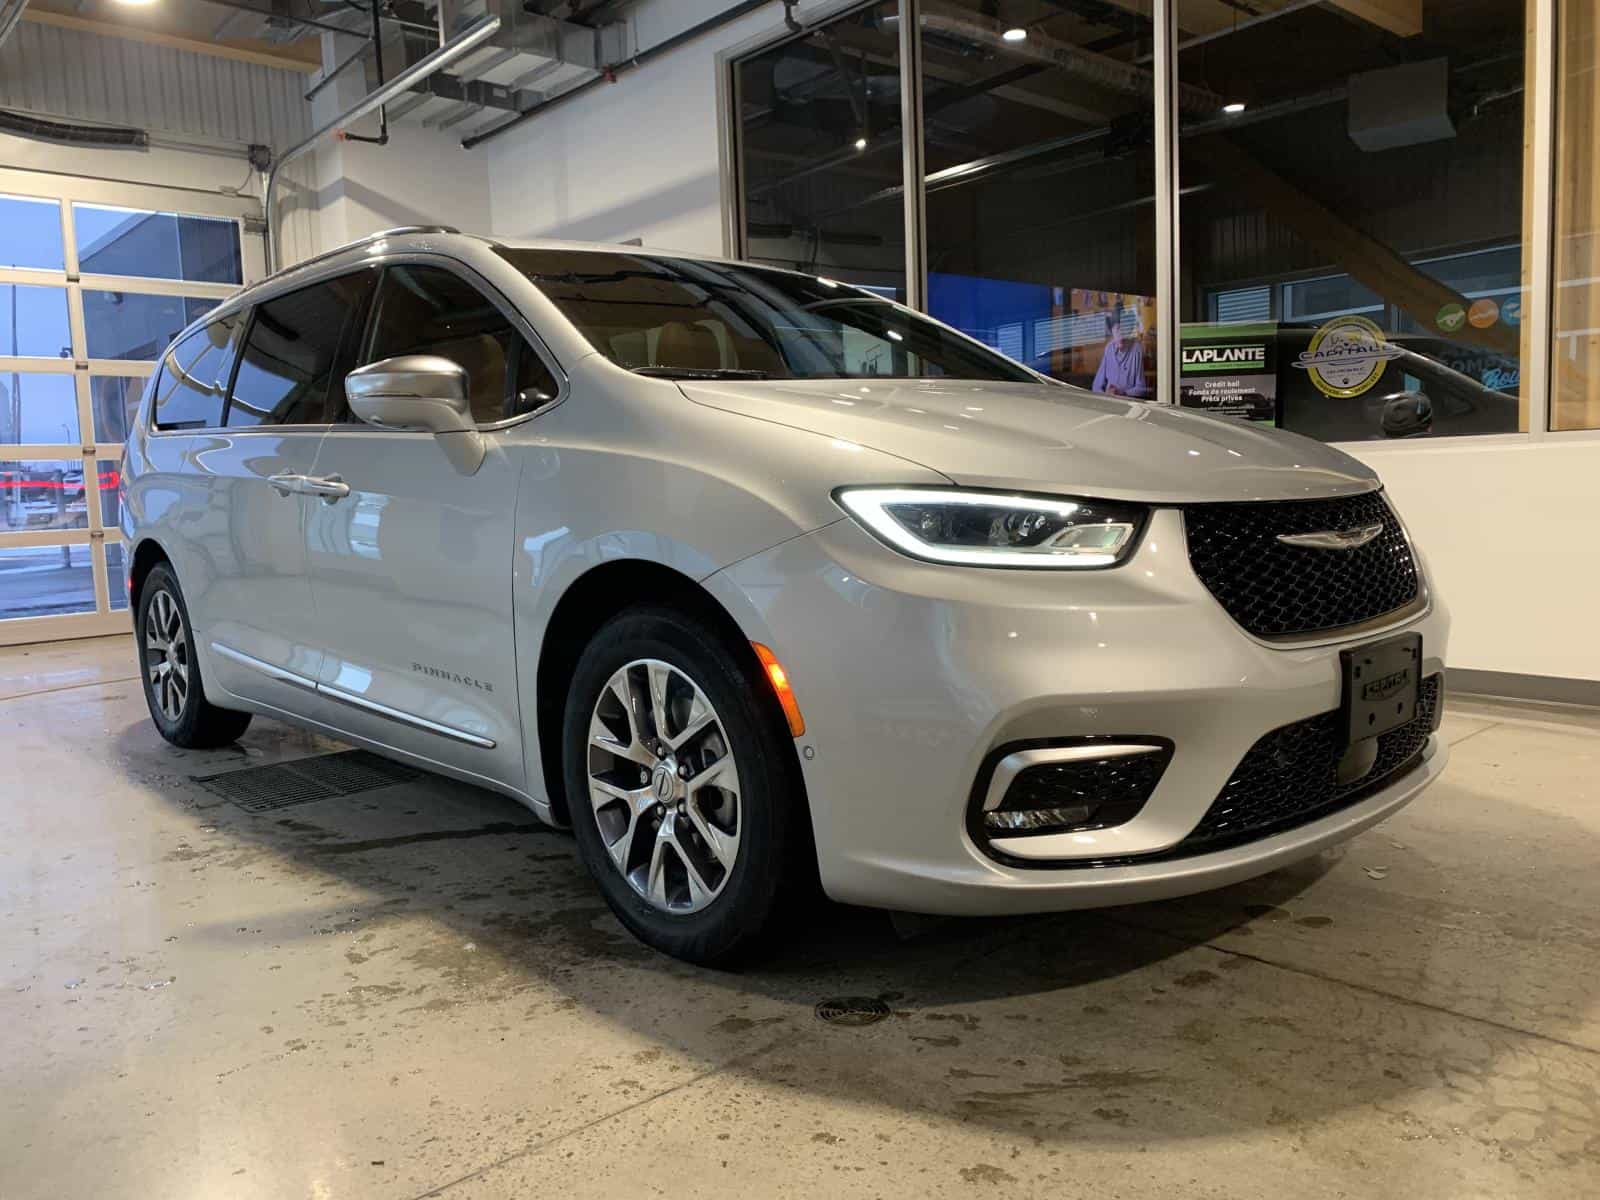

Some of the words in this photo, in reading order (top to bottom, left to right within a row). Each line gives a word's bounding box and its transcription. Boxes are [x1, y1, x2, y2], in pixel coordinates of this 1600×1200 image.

[1183, 347, 1265, 363] LAPLANTE
[1188, 389, 1210, 397] Fonds
[411, 662, 494, 692] PINNACLE
